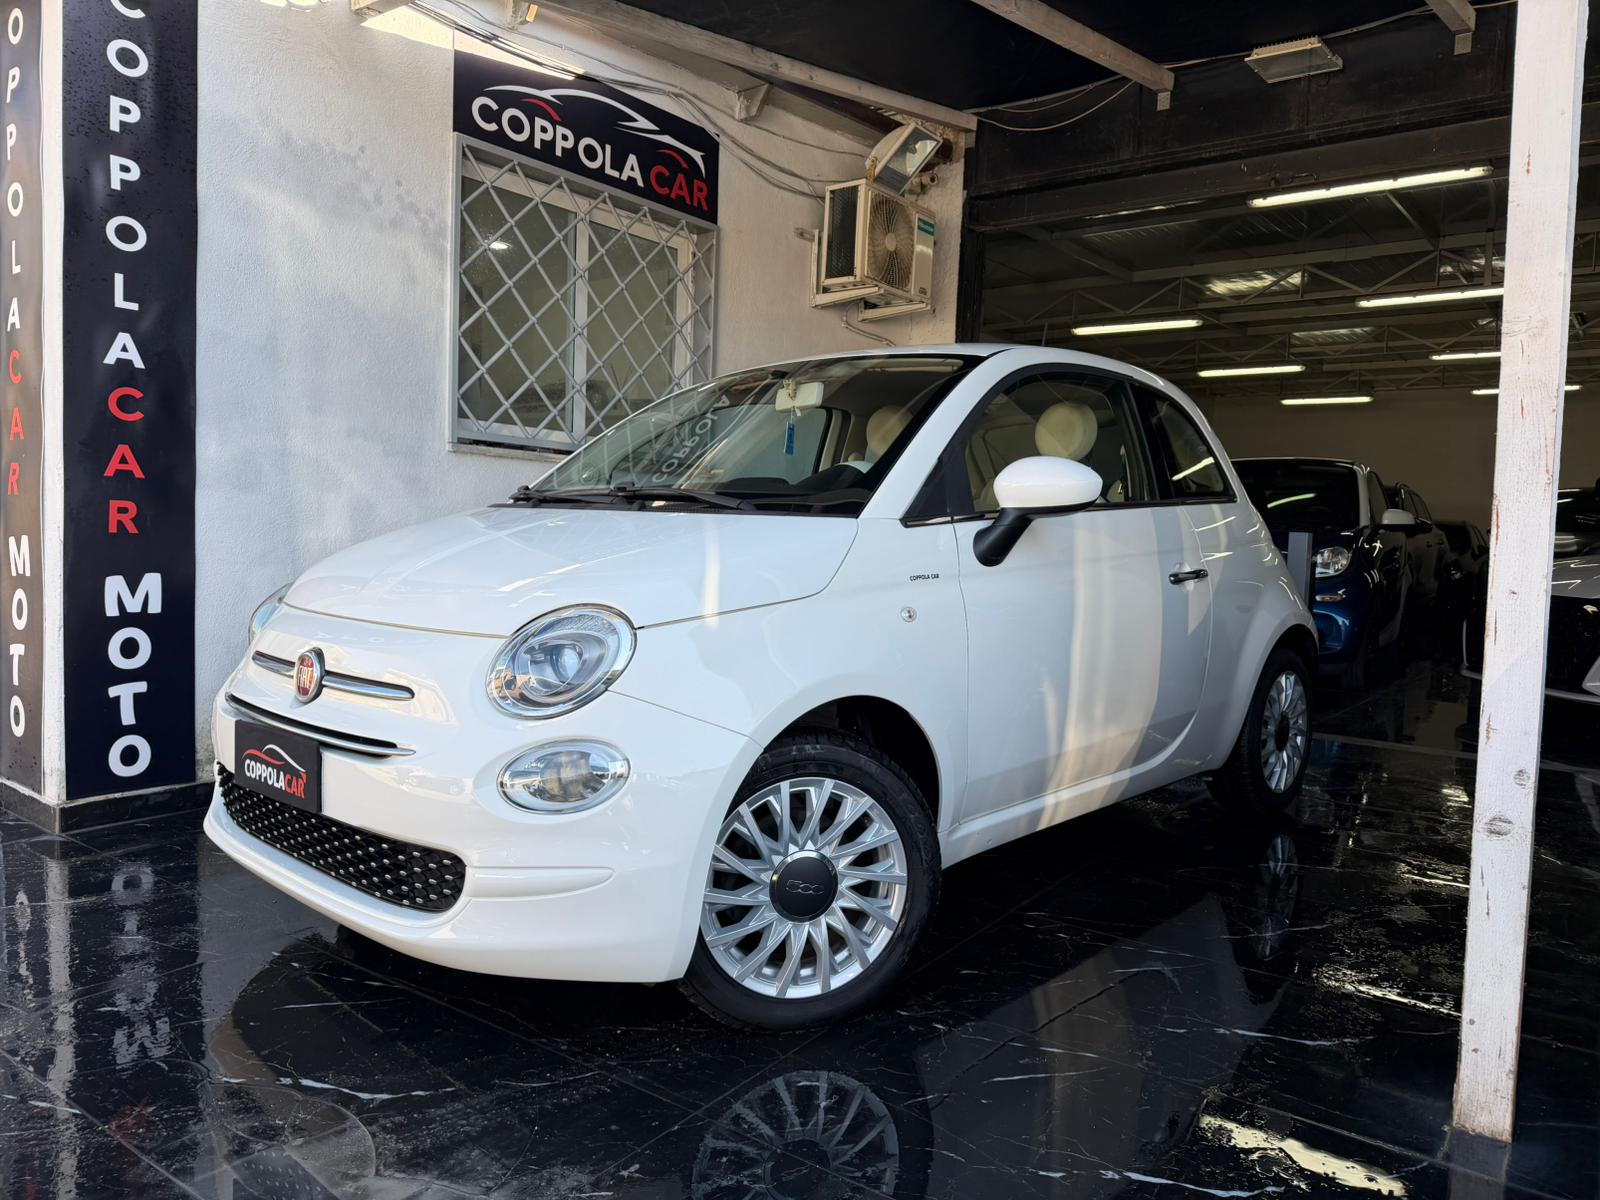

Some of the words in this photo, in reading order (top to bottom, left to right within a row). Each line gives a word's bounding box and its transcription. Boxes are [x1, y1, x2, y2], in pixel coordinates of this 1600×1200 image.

[471, 96, 644, 188] COPPOLA
[650, 164, 709, 212] CAR
[9, 534, 30, 737] MOTO
[104, 573, 162, 777] MOTO
